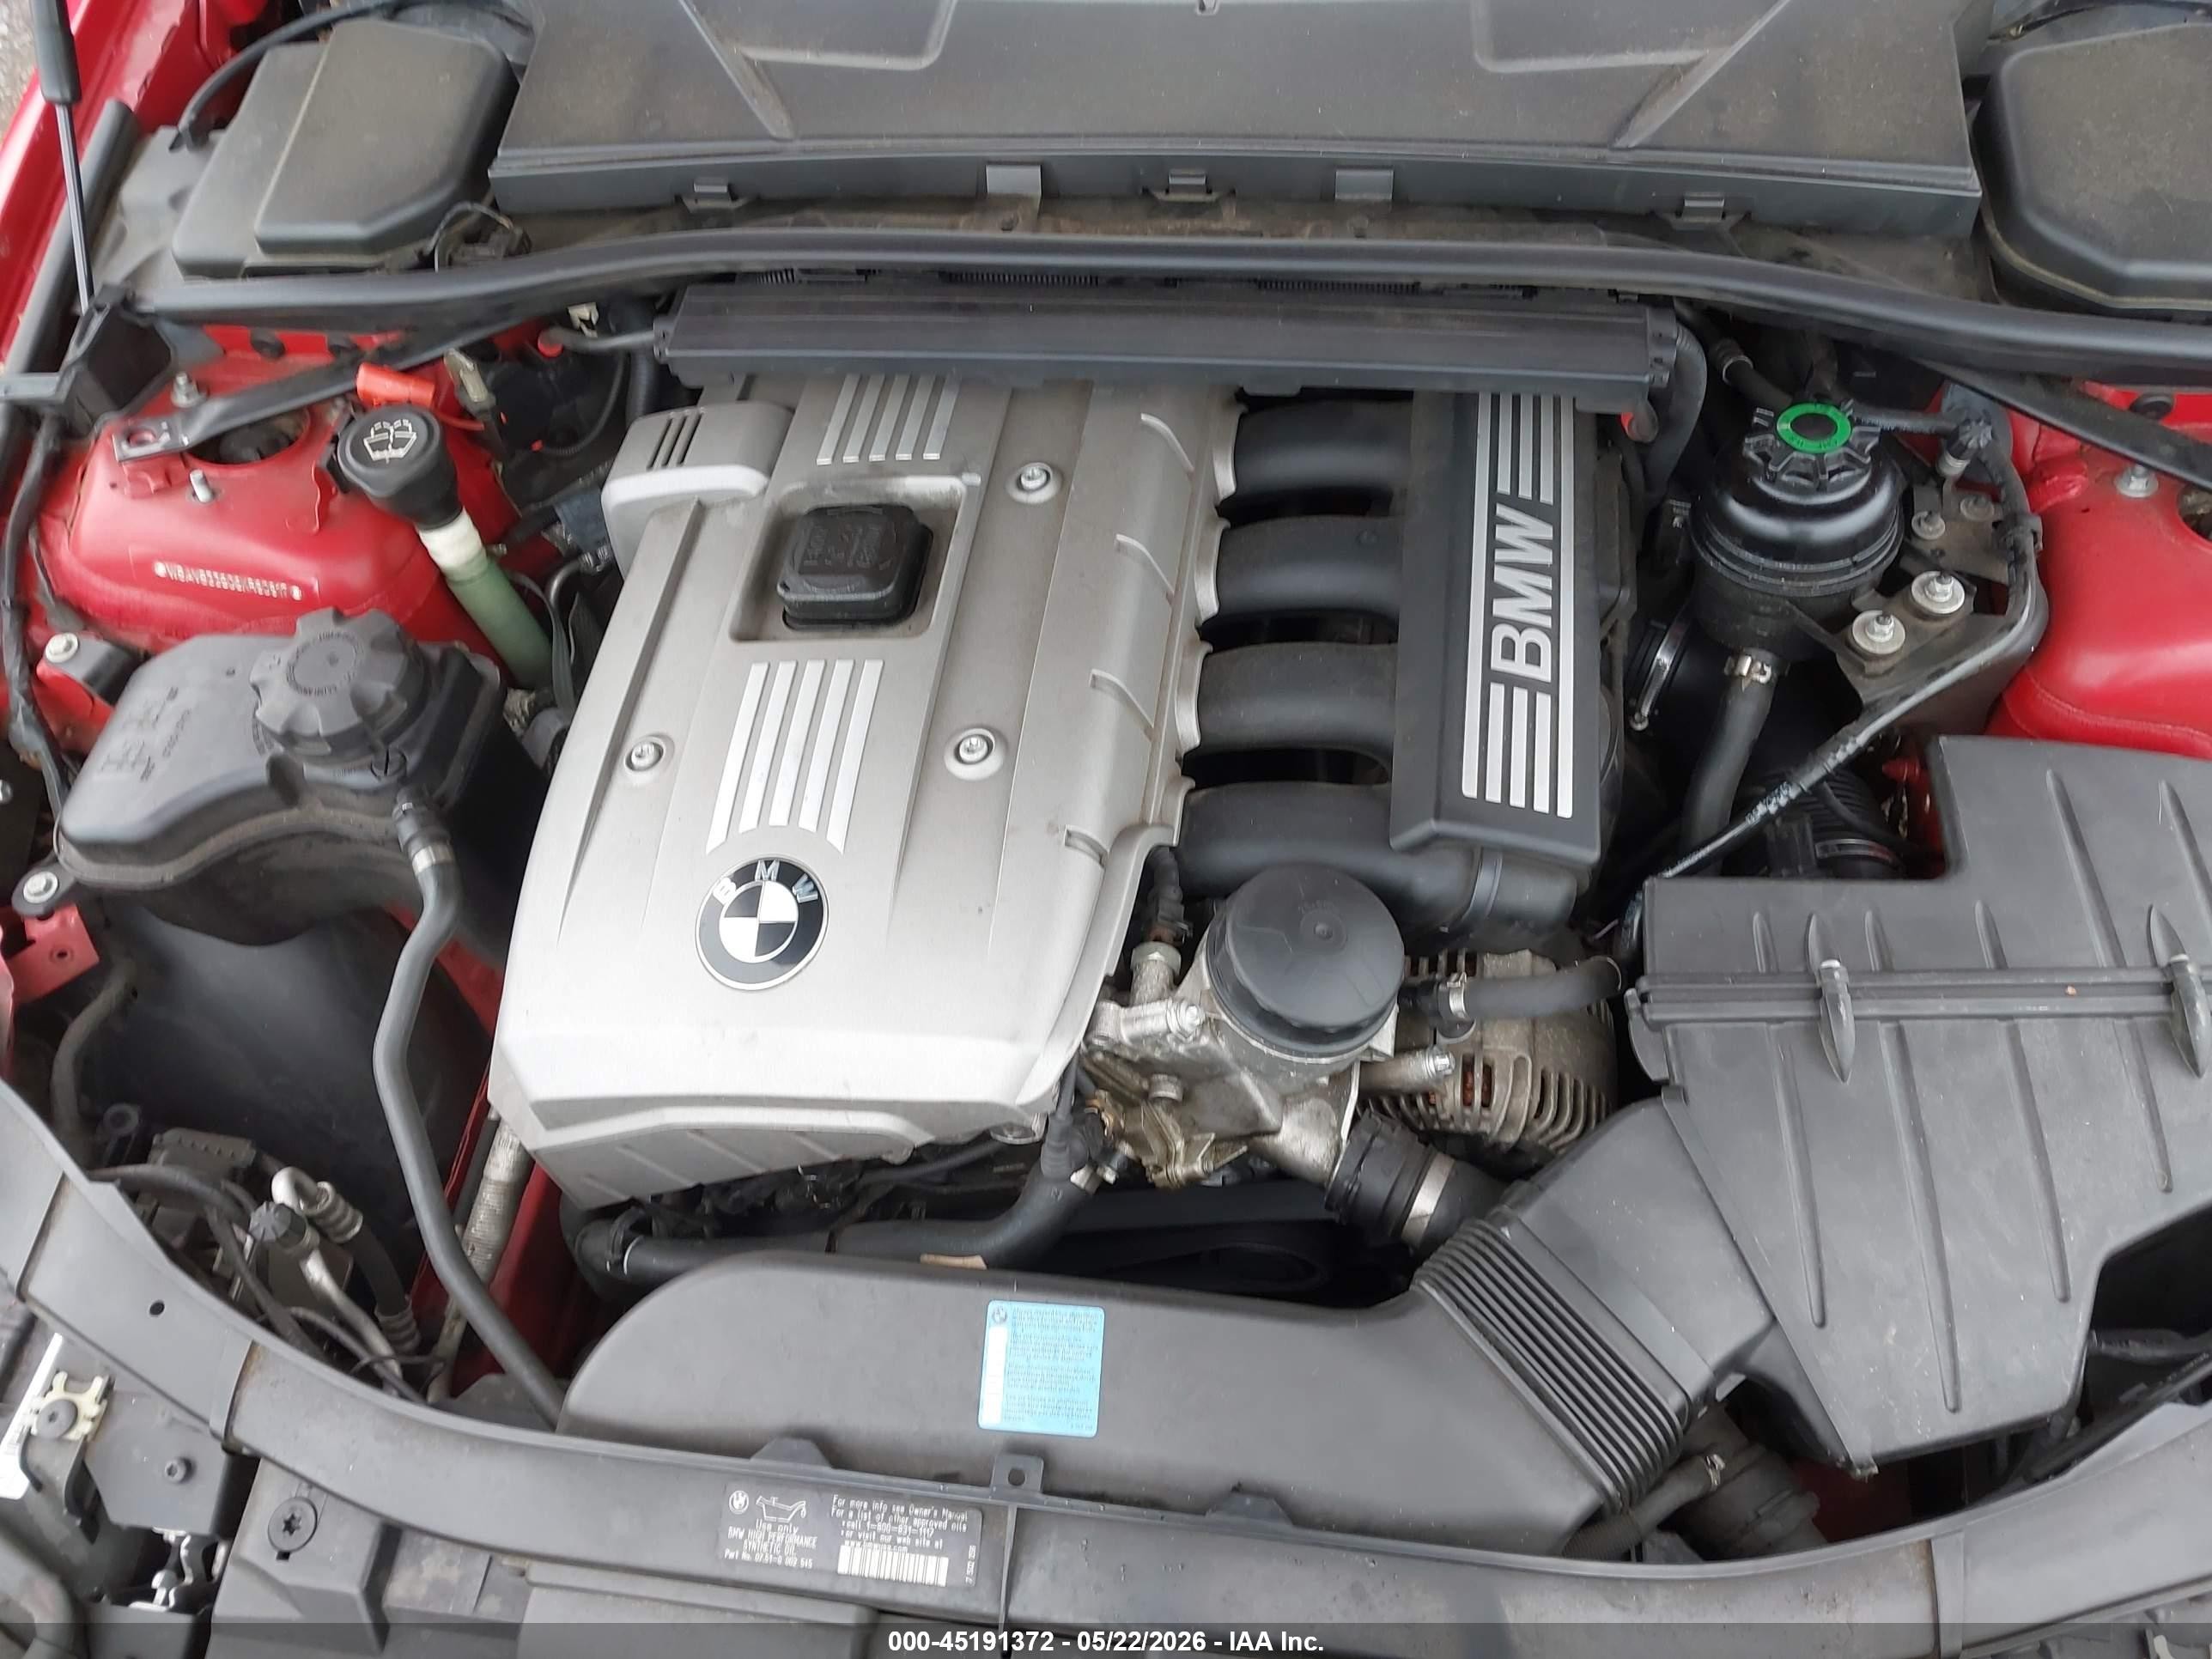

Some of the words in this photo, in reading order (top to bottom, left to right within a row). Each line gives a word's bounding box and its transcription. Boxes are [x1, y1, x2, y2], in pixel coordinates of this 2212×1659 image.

[1491, 501, 1553, 684] BMW
[713, 859, 818, 906] BMW
[831, 1506, 844, 1517] For
[858, 1509, 871, 1520] list
[876, 1513, 884, 1522] of
[889, 1511, 908, 1523] other
[914, 1517, 947, 1530] approved
[951, 1522, 966, 1532] oils
[833, 1494, 846, 1507] For
[850, 1499, 867, 1510] more
[872, 1499, 887, 1512] info
[892, 1504, 904, 1513] see
[908, 1504, 937, 1516] Owner's
[942, 1508, 968, 1522] Manual
[728, 1526, 744, 1539] BMW
[748, 1528, 765, 1542] HIGH
[767, 1532, 817, 1549] PERFORMANCE
[756, 1518, 772, 1531] Use
[778, 1523, 799, 1535] only
[743, 1539, 781, 1555] SYNTHETIC
[785, 1544, 796, 1556] OIL
[858, 1530, 876, 1540] visit
[880, 1534, 891, 1543] our
[896, 1535, 910, 1545] web
[915, 1537, 930, 1547] site
[935, 1539, 943, 1550] at
[725, 1548, 738, 1559] Part
[742, 1551, 751, 1560] No.
